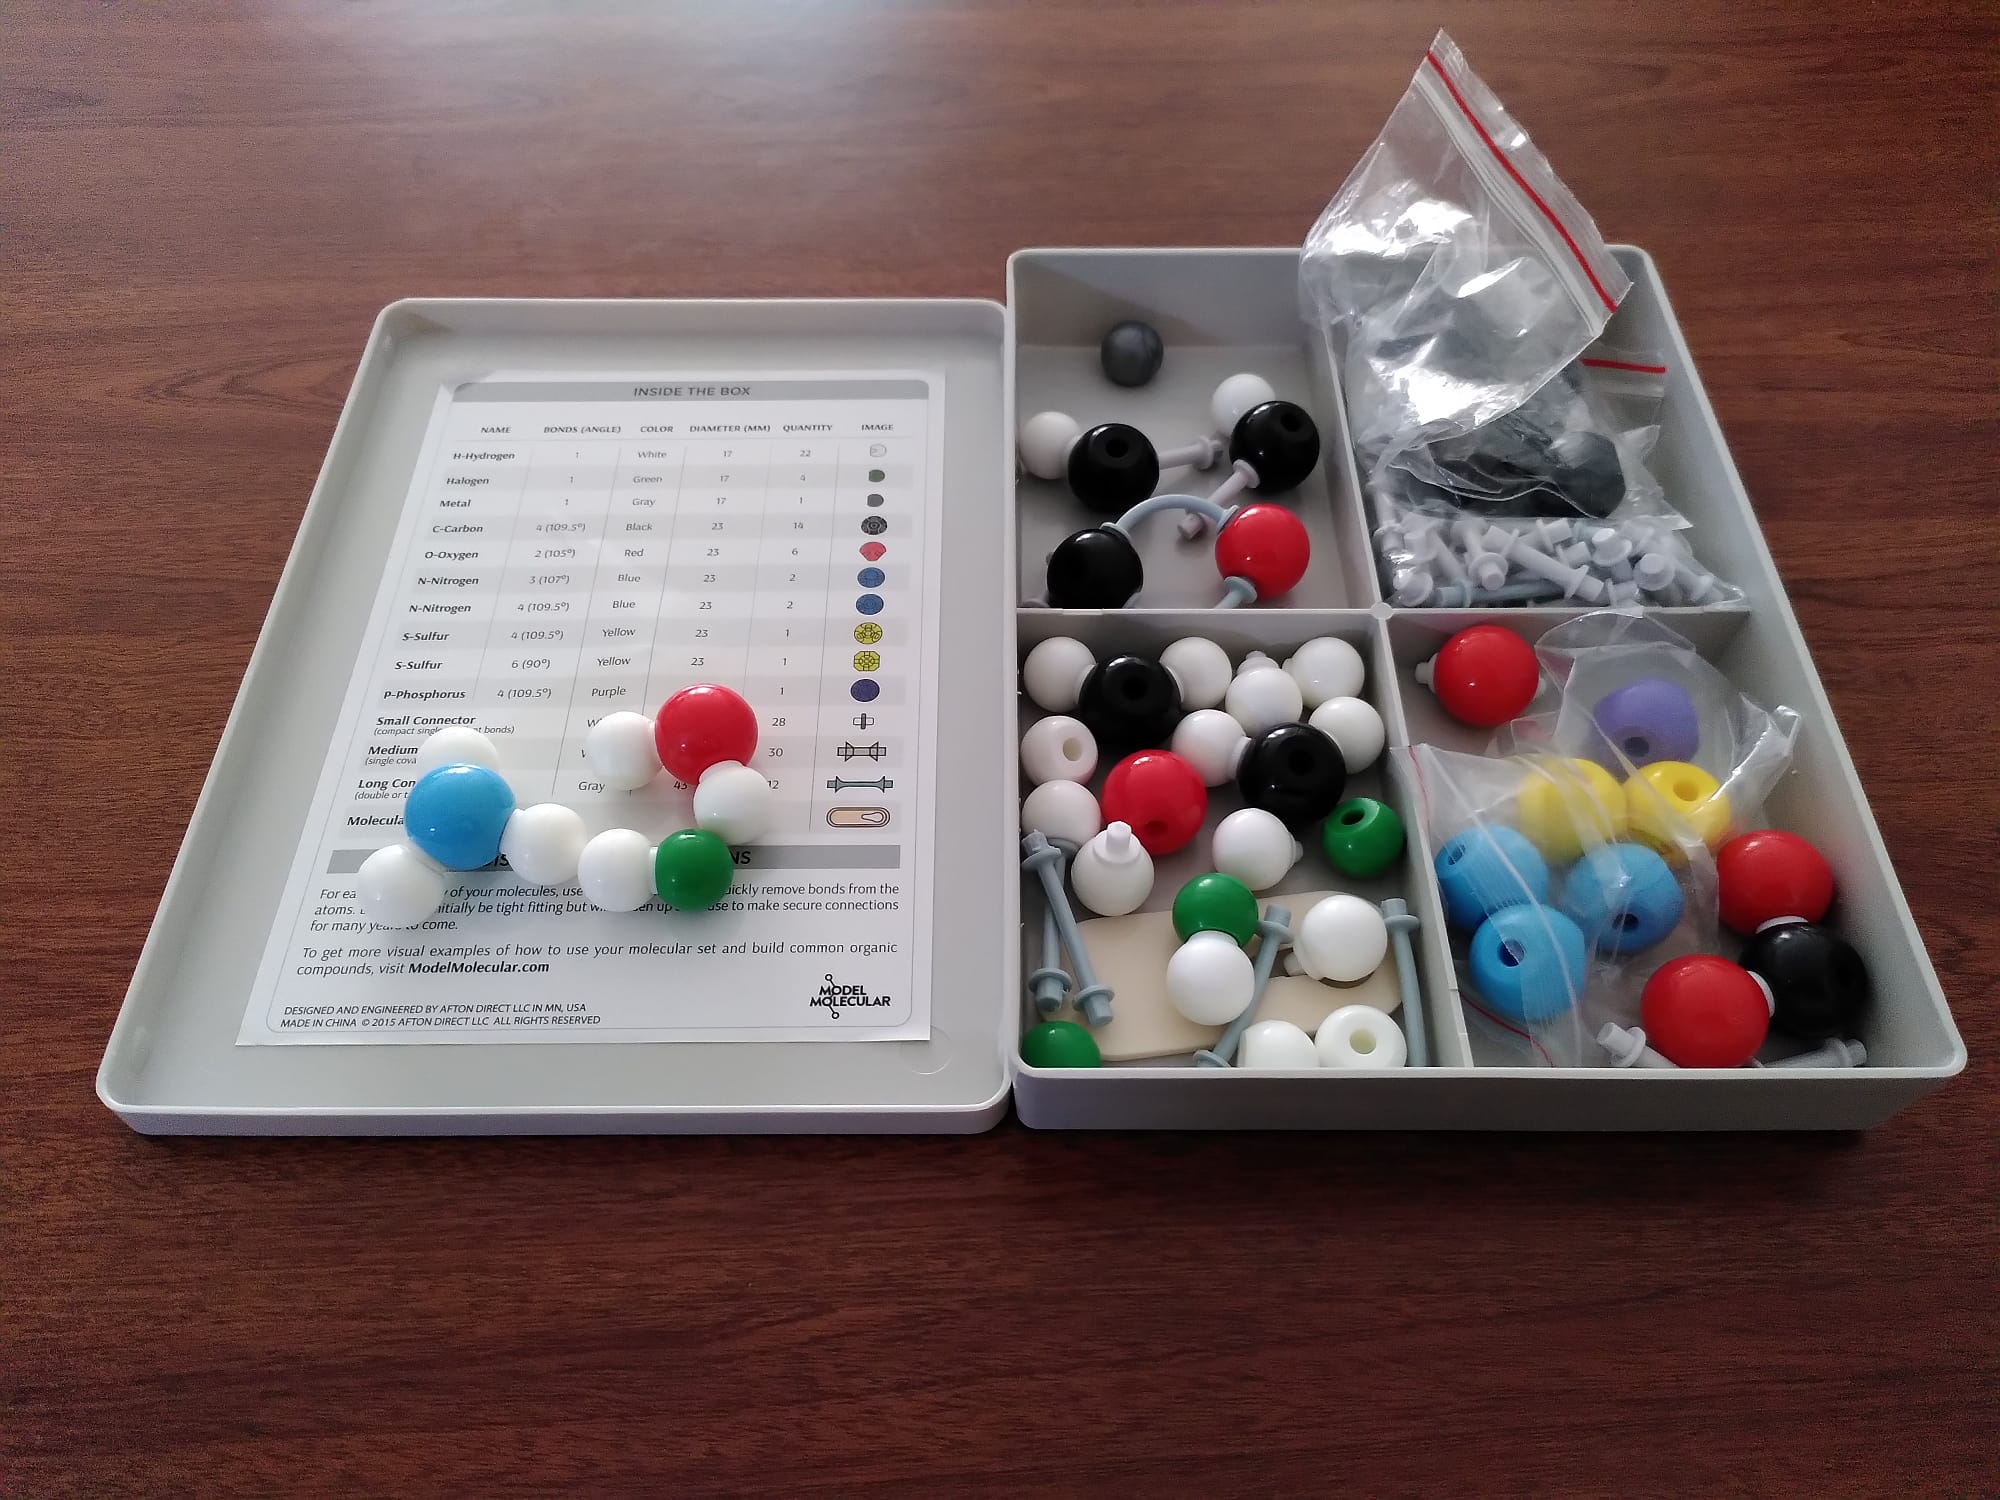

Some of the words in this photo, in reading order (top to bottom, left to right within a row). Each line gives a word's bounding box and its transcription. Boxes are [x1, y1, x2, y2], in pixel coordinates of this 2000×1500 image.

[634, 388, 683, 397] INSIDE
[688, 387, 716, 395] THE
[720, 387, 751, 395] BOX
[581, 426, 621, 434] (ANGLE)
[744, 424, 771, 433] (MM)
[783, 424, 833, 432] QUANTITY
[454, 452, 515, 461] H-Hydrogen
[447, 477, 489, 486] Halogen
[440, 499, 471, 507] Metal
[633, 499, 655, 507] Gray
[626, 523, 652, 531] Black
[425, 552, 478, 560] O-Oxygen
[534, 550, 541, 558] 2
[707, 548, 719, 556] 23
[418, 577, 478, 587] N-Nitrogen
[529, 576, 536, 584] 3
[618, 574, 640, 582] Blue
[789, 574, 796, 582] 2
[409, 604, 471, 614] N-Nitrogen
[517, 603, 524, 611] 4
[613, 600, 635, 608] Blue
[699, 601, 712, 609] 23
[787, 601, 793, 609] 2
[402, 632, 449, 640] S-Sulfur
[511, 631, 517, 639] 4
[603, 628, 635, 637] Yellow
[785, 629, 789, 637] 1
[395, 661, 443, 669] S-Sulfur
[512, 660, 518, 668] 6
[597, 657, 630, 666] Yellow
[691, 658, 704, 666] 23
[782, 658, 786, 666] 1
[384, 690, 465, 701] P-Phosphorus
[497, 690, 504, 698] 4
[592, 686, 626, 698] Purple
[780, 687, 783, 695] 1
[376, 716, 410, 725] Small
[413, 717, 476, 725] Connector
[772, 717, 786, 726] 28
[374, 728, 415, 736] (compact
[484, 726, 514, 734] bonds)
[368, 745, 418, 754] Medium
[768, 748, 783, 757] 30
[365, 757, 394, 766] (single
[359, 780, 388, 791] Long
[579, 782, 605, 793] Gray
[355, 791, 389, 800] (double
[320, 889, 340, 899] For
[450, 886, 465, 898] of
[463, 887, 493, 900] your
[496, 885, 558, 897] molecules,
[563, 888, 583, 896] use
[809, 883, 845, 894] bonds
[849, 883, 876, 894] from
[880, 883, 899, 894] the
[315, 905, 355, 915] atoms.
[478, 902, 494, 913] be
[497, 902, 525, 916] tight
[528, 901, 568, 916] fitting
[569, 901, 588, 912] but
[732, 901, 744, 910] to
[748, 899, 779, 910] make
[783, 902, 822, 910] secure
[825, 900, 898, 910] connections
[311, 920, 328, 931] for
[332, 923, 366, 934] many
[422, 921, 458, 930] come.
[303, 947, 318, 958] To
[321, 948, 343, 961] get
[349, 949, 381, 957] more
[388, 945, 425, 956] visual
[430, 944, 490, 959] examples
[496, 944, 511, 956] of
[515, 944, 542, 955] how
[548, 945, 561, 956] to
[567, 947, 588, 955] use
[597, 944, 622, 956] your
[629, 943, 692, 954] molecular
[697, 944, 716, 953] set
[722, 942, 746, 953] and
[753, 942, 784, 953] build
[790, 945, 843, 953] common
[850, 944, 897, 956] organic
[297, 963, 373, 977] compounds,
[380, 963, 405, 974] visit
[409, 961, 549, 973] ModelMolecular.com
[819, 985, 866, 995] MODEL
[809, 995, 890, 1007] MOLECULAR
[285, 1007, 334, 1015] DESIGNED
[336, 1006, 359, 1014] AND
[361, 1005, 423, 1014] ENGINEERED
[425, 1005, 438, 1014] BY
[440, 1005, 474, 1013] AFTON
[476, 1004, 511, 1012] DIRECT
[513, 1004, 530, 1012] LLC
[532, 1004, 543, 1012] IN
[545, 1004, 563, 1012] MN,
[281, 1019, 310, 1027] MADE
[313, 1019, 323, 1027] IN
[326, 1019, 356, 1027] CHINA
[372, 1018, 396, 1026] 2015
[398, 1018, 432, 1026] AFTON
[434, 1017, 470, 1025] DIRECT
[472, 1017, 489, 1025] LLC
[493, 1017, 510, 1025] ALL
[514, 1016, 549, 1024] RIGHTS
[552, 1016, 600, 1024] RESERVED
